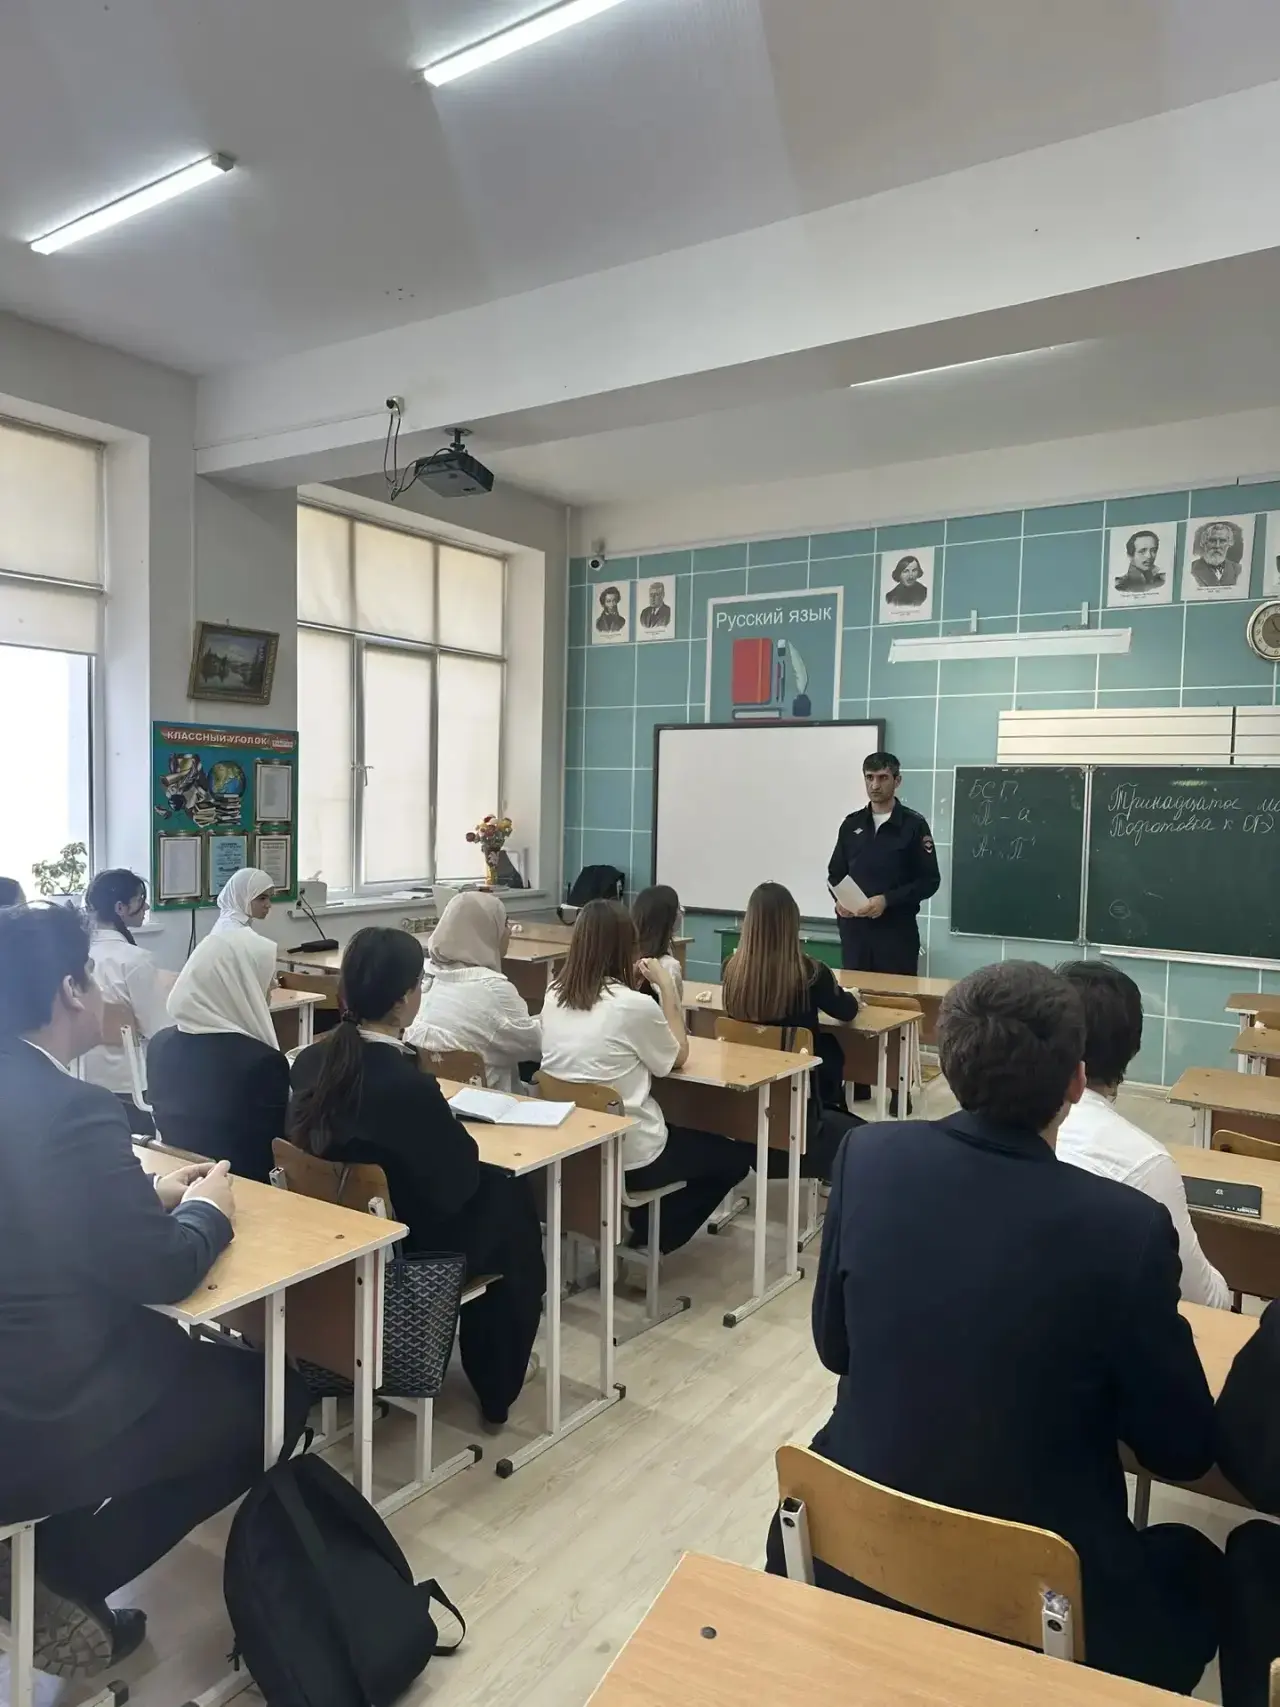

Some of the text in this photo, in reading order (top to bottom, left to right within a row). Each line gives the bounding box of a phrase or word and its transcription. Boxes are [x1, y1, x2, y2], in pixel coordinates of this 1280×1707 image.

[716, 607, 832, 632] Русский язык
[167, 731, 227, 743] КЛАССНЫЙ
[229, 735, 267, 745] УГОЛОК
[1108, 782, 1242, 821] Тринадцатое
[1110, 813, 1215, 846] Подготовка
[1223, 818, 1233, 831] к
